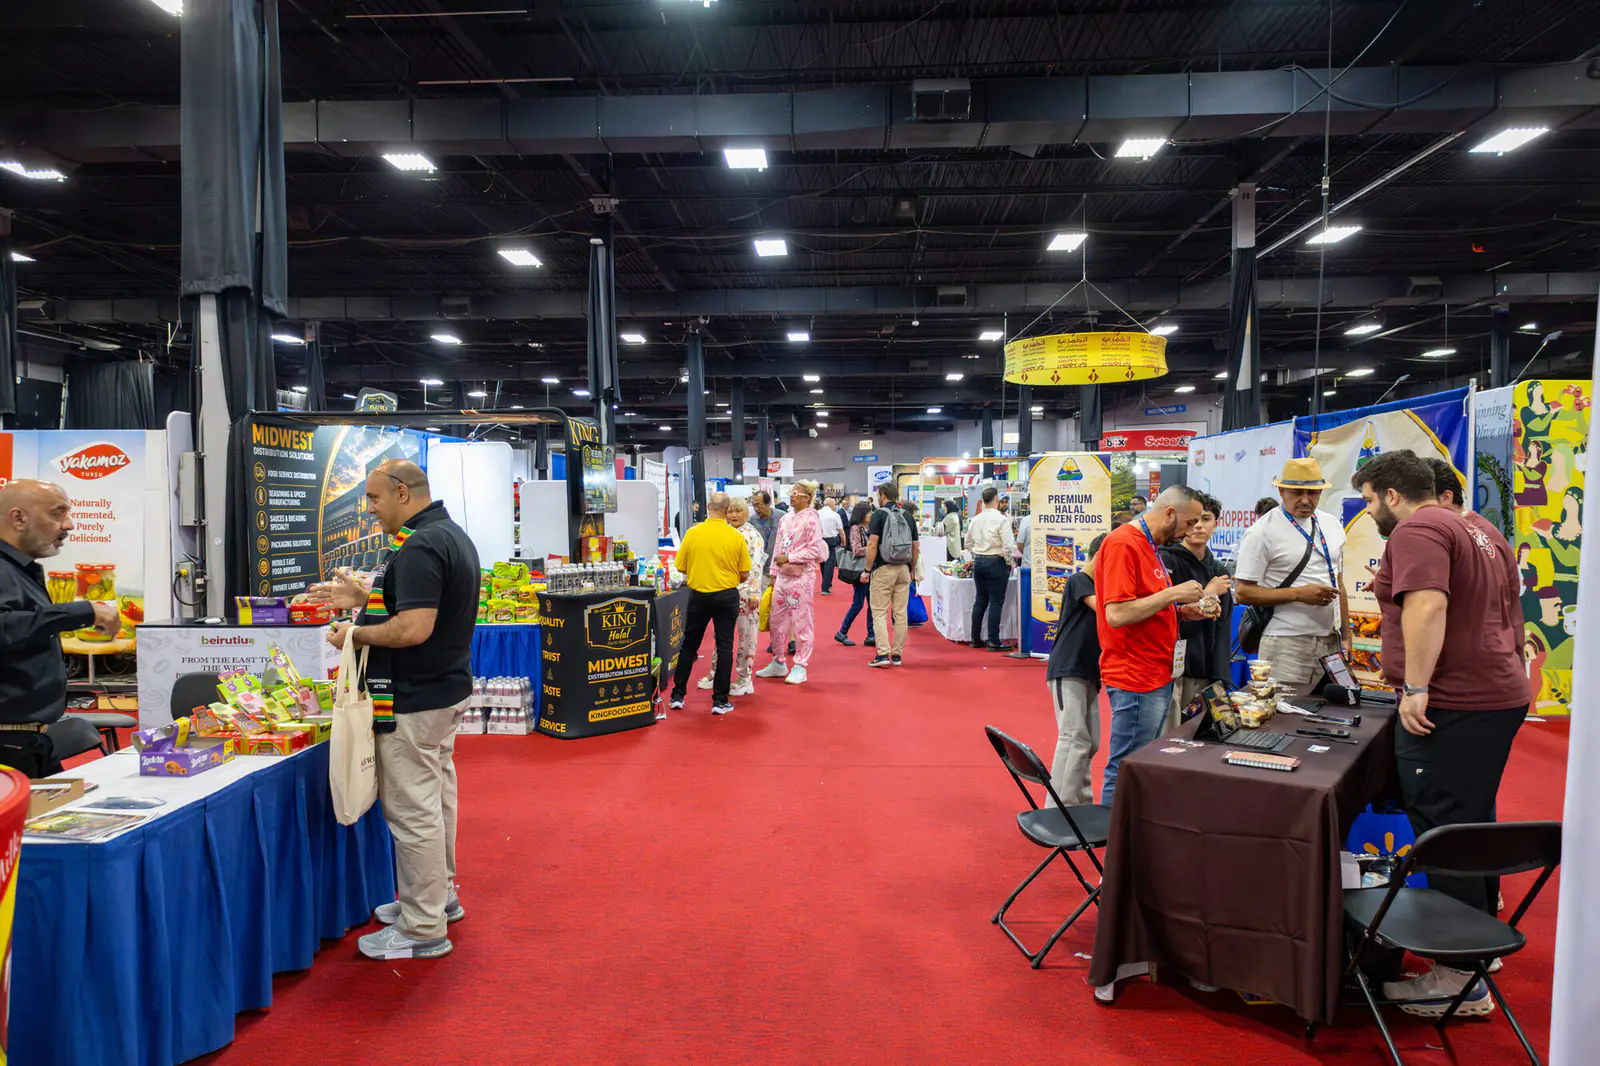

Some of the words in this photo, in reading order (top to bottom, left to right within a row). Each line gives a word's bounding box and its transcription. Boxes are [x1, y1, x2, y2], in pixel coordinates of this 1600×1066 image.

[252, 424, 314, 450] MIDWEST
[568, 420, 599, 446] KING
[254, 446, 288, 458] DISTRIBUTION
[289, 451, 314, 461] SOLUTIONS
[60, 454, 126, 474] yakamoz
[70, 498, 112, 509] Naturally
[1048, 494, 1092, 504] PREMIUM
[69, 511, 116, 520] ermented,
[1055, 505, 1085, 514] HALAL
[1039, 515, 1072, 523] FROZEN
[1074, 515, 1102, 523] FOODS
[76, 522, 104, 532] Purely
[70, 534, 111, 542] Delicious!
[283, 566, 301, 574] IMPORTER
[288, 582, 305, 590] LABELING
[540, 616, 564, 628] QUALITY
[602, 612, 636, 628] KING
[609, 628, 631, 640] Halal
[542, 650, 560, 662] TRUST
[588, 653, 648, 673] MIDWEST
[588, 671, 623, 680] DISTRIBUTION
[624, 666, 648, 675] SOLUTIONS
[543, 684, 561, 696] TASTE
[590, 704, 649, 719] KINGFOODCC.COM
[540, 718, 566, 732] SERVICE
